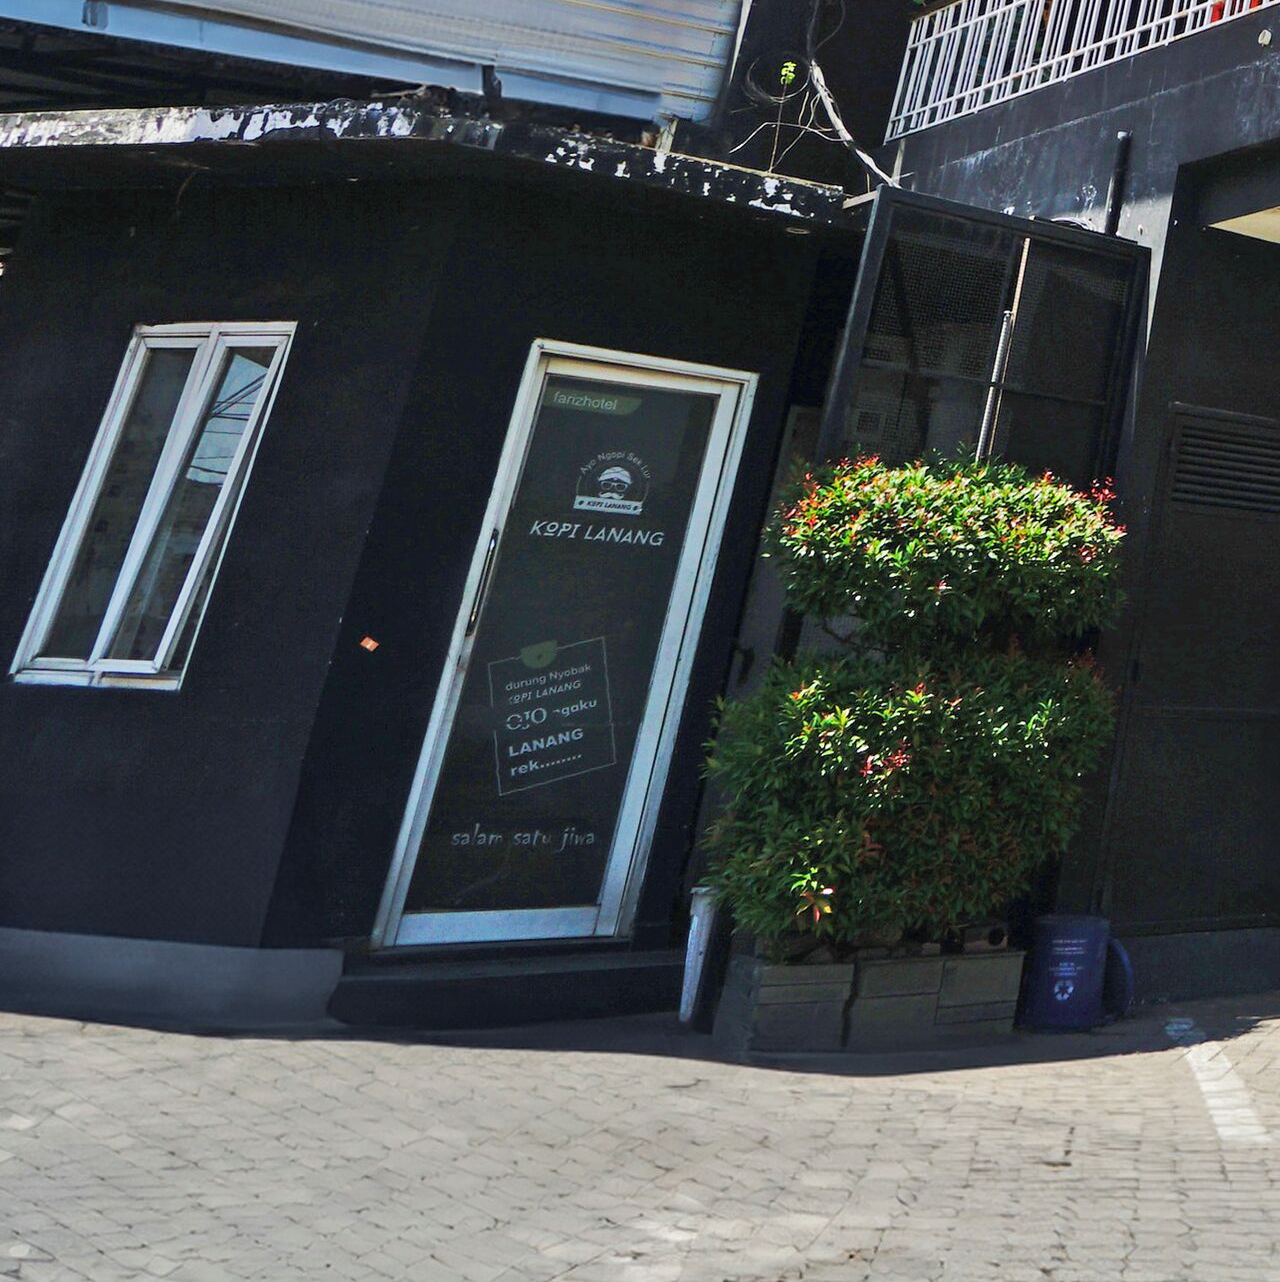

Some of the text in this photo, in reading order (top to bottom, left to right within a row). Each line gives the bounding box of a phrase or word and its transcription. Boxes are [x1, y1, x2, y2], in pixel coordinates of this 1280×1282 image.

[597, 451, 625, 462] Ngopi
[529, 520, 665, 546] KOPI LANANG
[505, 663, 591, 692] durung Nyobak
[536, 680, 582, 699] LANANG
[508, 728, 584, 758] LANANG
[451, 823, 503, 846] salam
[513, 829, 551, 846] satu
